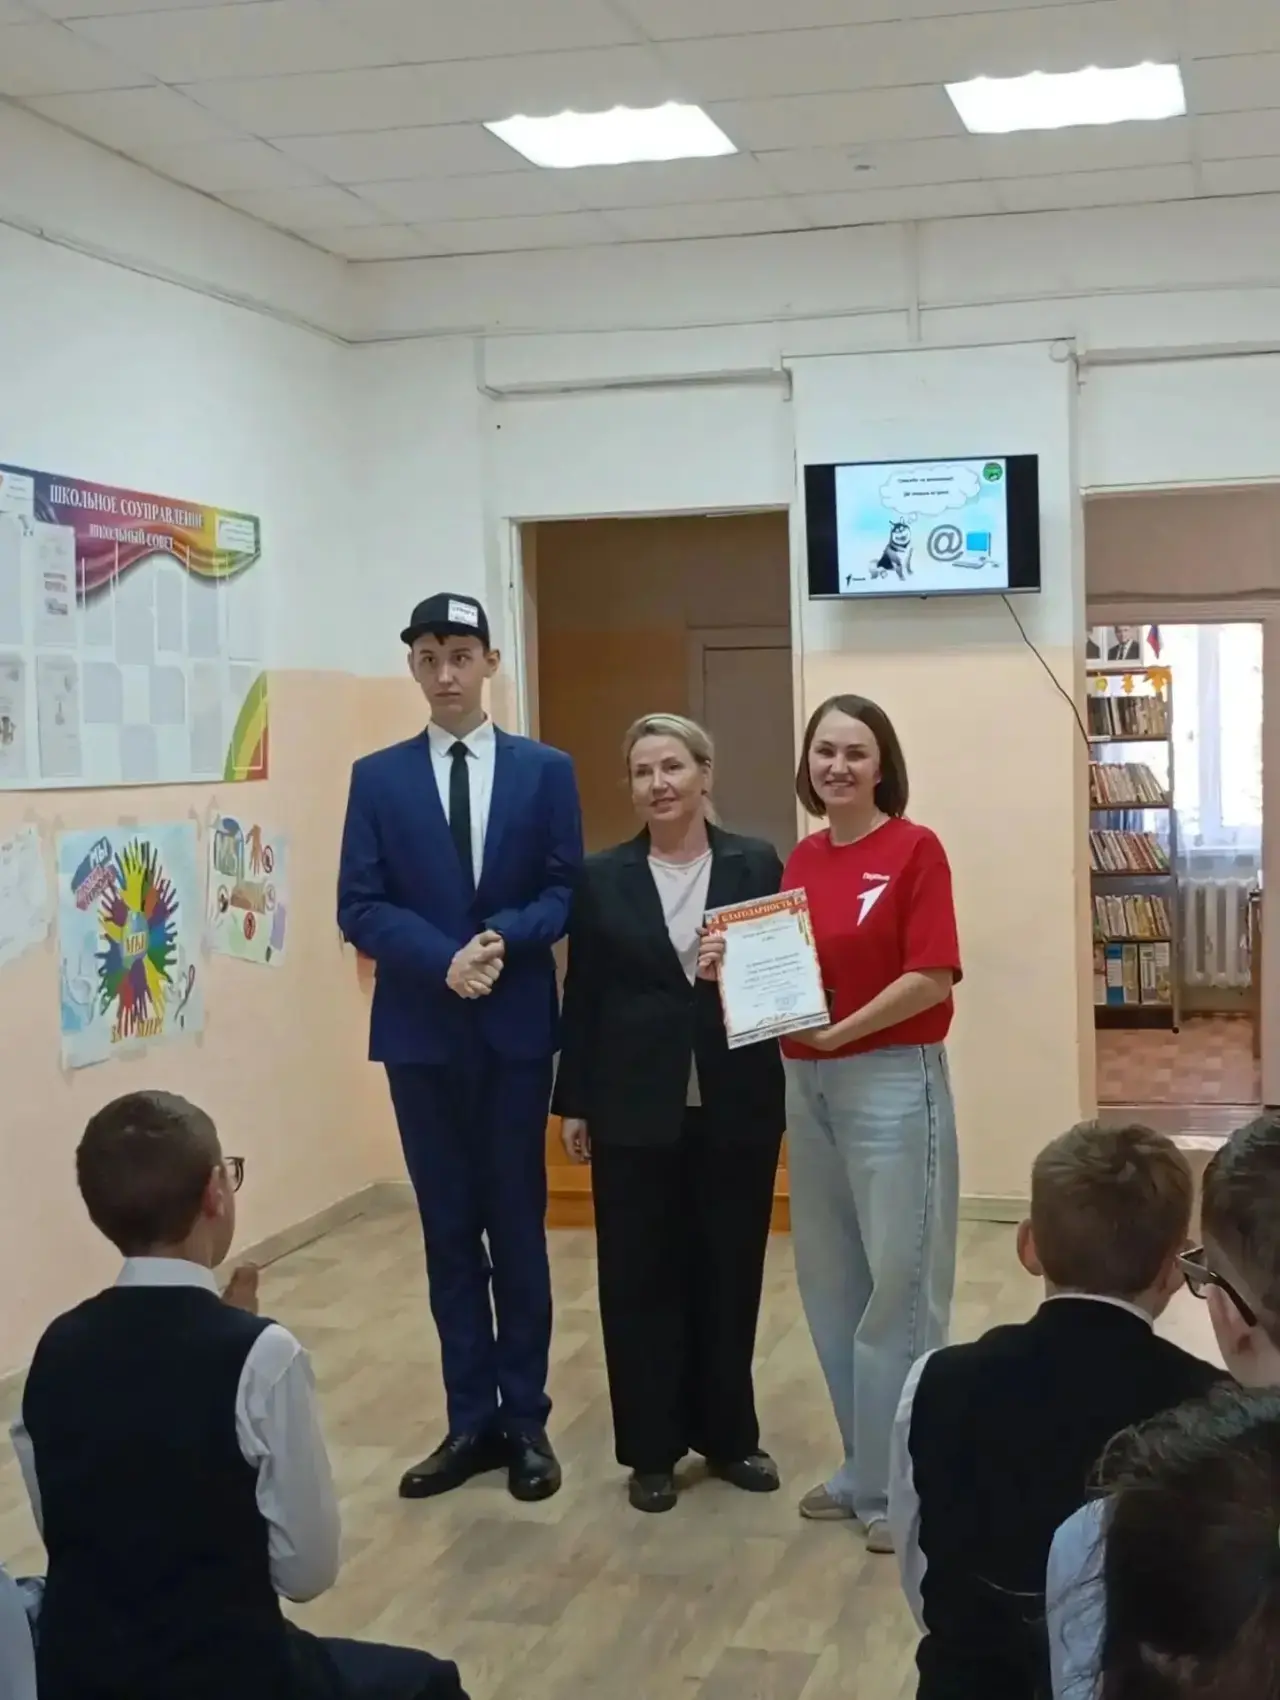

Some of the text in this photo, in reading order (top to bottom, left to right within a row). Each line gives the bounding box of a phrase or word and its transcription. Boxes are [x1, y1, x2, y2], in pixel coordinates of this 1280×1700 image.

[50, 484, 118, 514] ШКОЛЬНОЕ
[120, 499, 205, 528] СОУПРАВЛЕНИЕ
[89, 523, 174, 550] ШКОЛЬНЫЙ СОВЕТ
[721, 899, 793, 922] БЛАГОДАРНОСТЬ
[126, 933, 145, 953] МЫ
